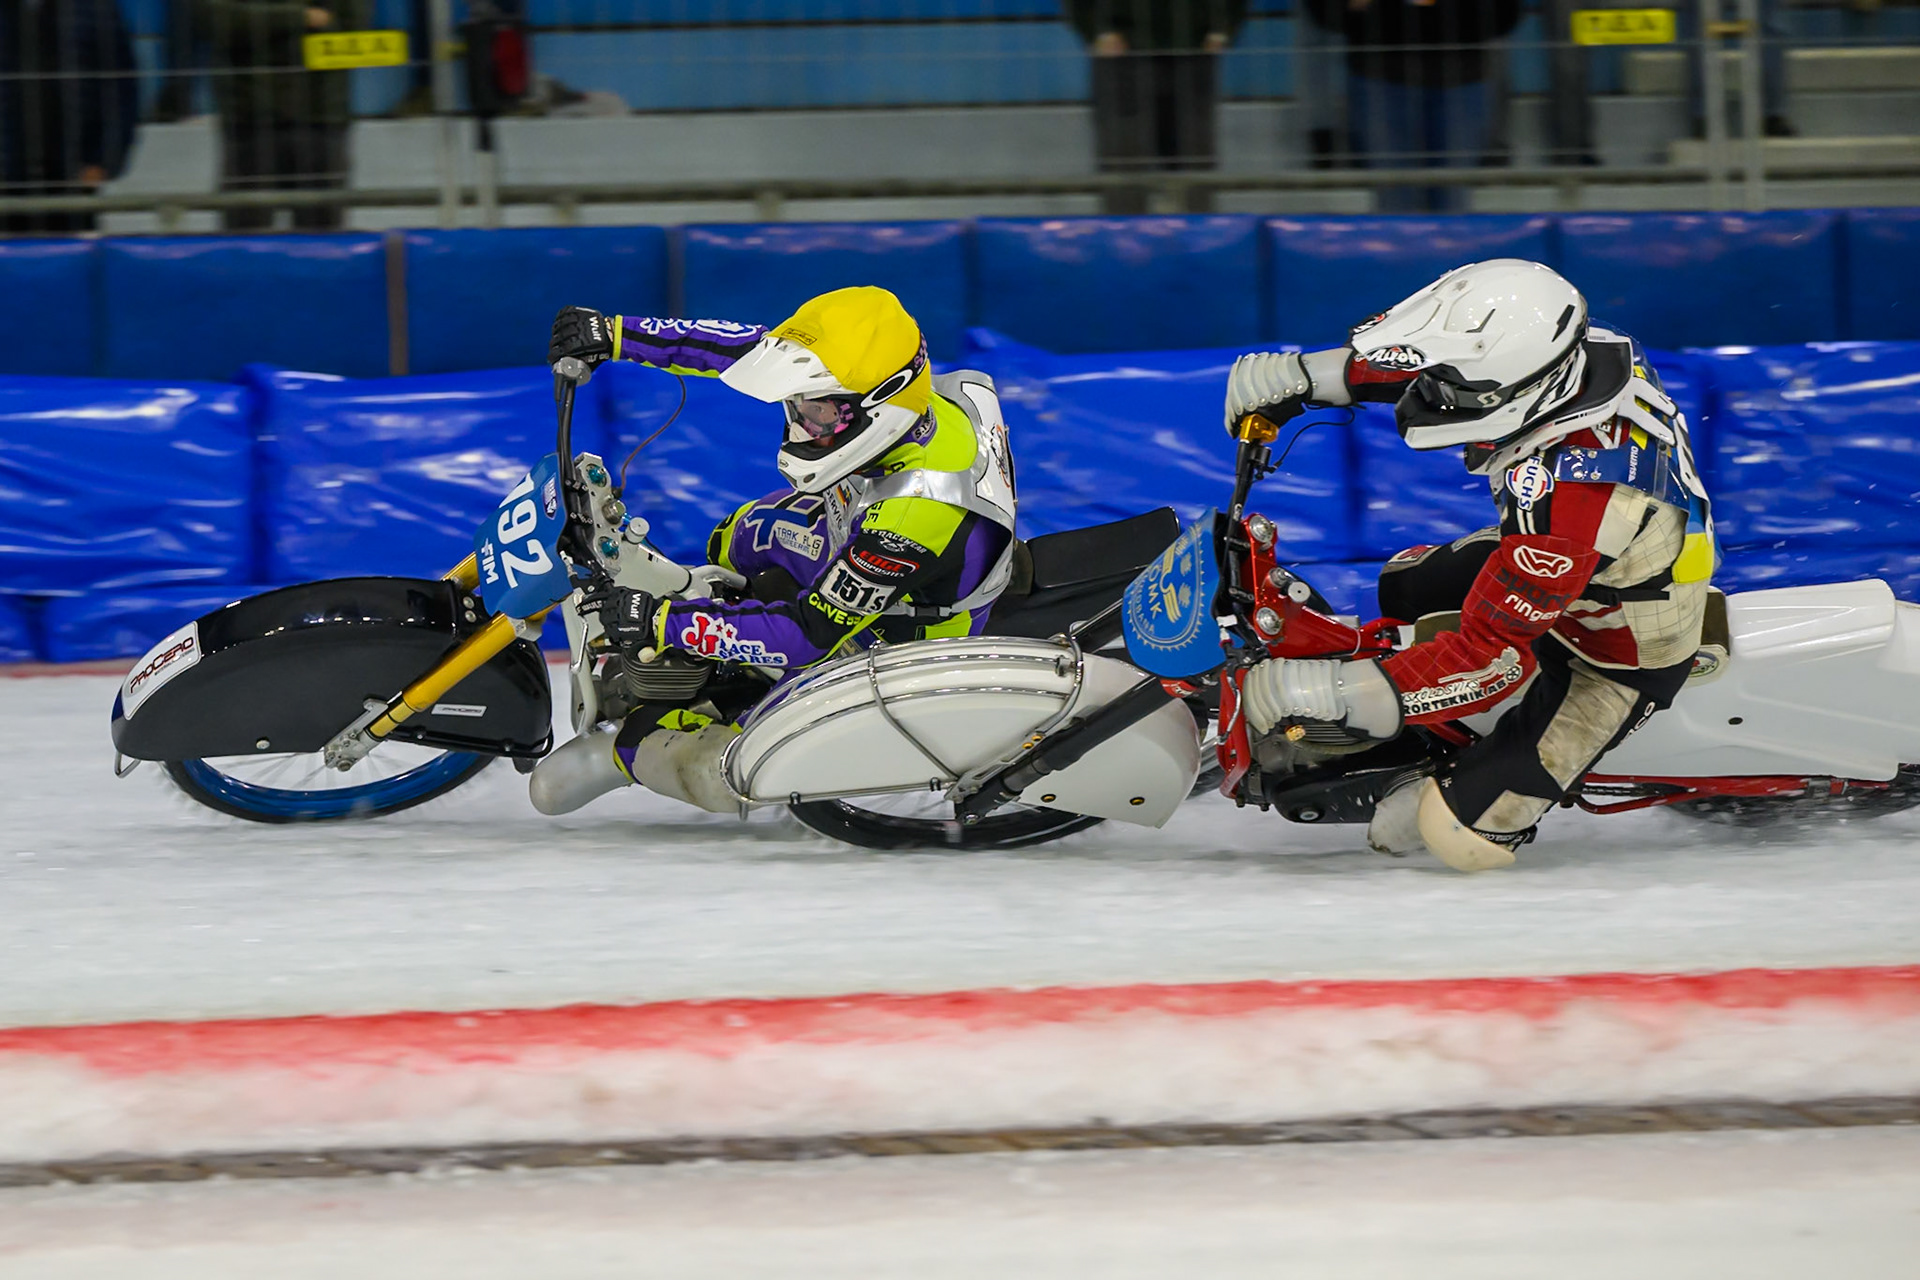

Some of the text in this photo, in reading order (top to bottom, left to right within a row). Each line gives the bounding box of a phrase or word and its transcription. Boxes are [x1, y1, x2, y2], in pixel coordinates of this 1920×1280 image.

[589, 316, 602, 341] Wulf
[1366, 346, 1422, 366] Airoh
[1519, 455, 1540, 508] FUCHS
[497, 471, 554, 589] 192
[481, 537, 499, 585] FIM
[860, 550, 904, 572] EDGE
[630, 593, 642, 620] Wulf
[808, 593, 848, 624] CLIVE
[1504, 594, 1561, 622] ringen
[130, 636, 194, 694] PROCERO
[1487, 679, 1507, 696] AB
